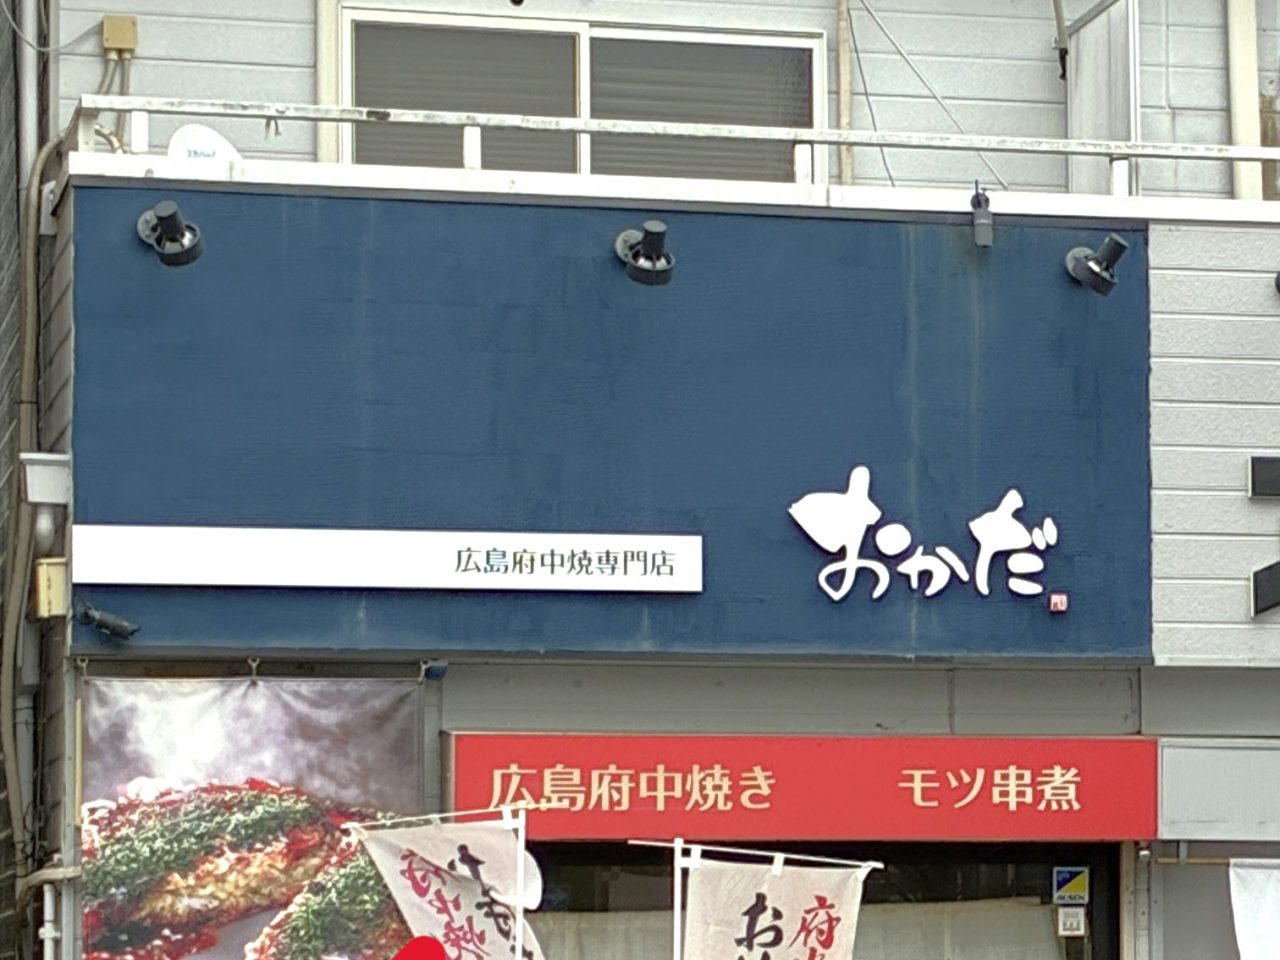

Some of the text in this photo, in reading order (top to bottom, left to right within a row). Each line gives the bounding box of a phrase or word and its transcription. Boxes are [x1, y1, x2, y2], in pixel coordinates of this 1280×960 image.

[787, 465, 1058, 601] おかだ
[455, 547, 676, 577] 広島府中焼専門店
[489, 763, 1082, 813] 広島府中焼き モツ串煮
